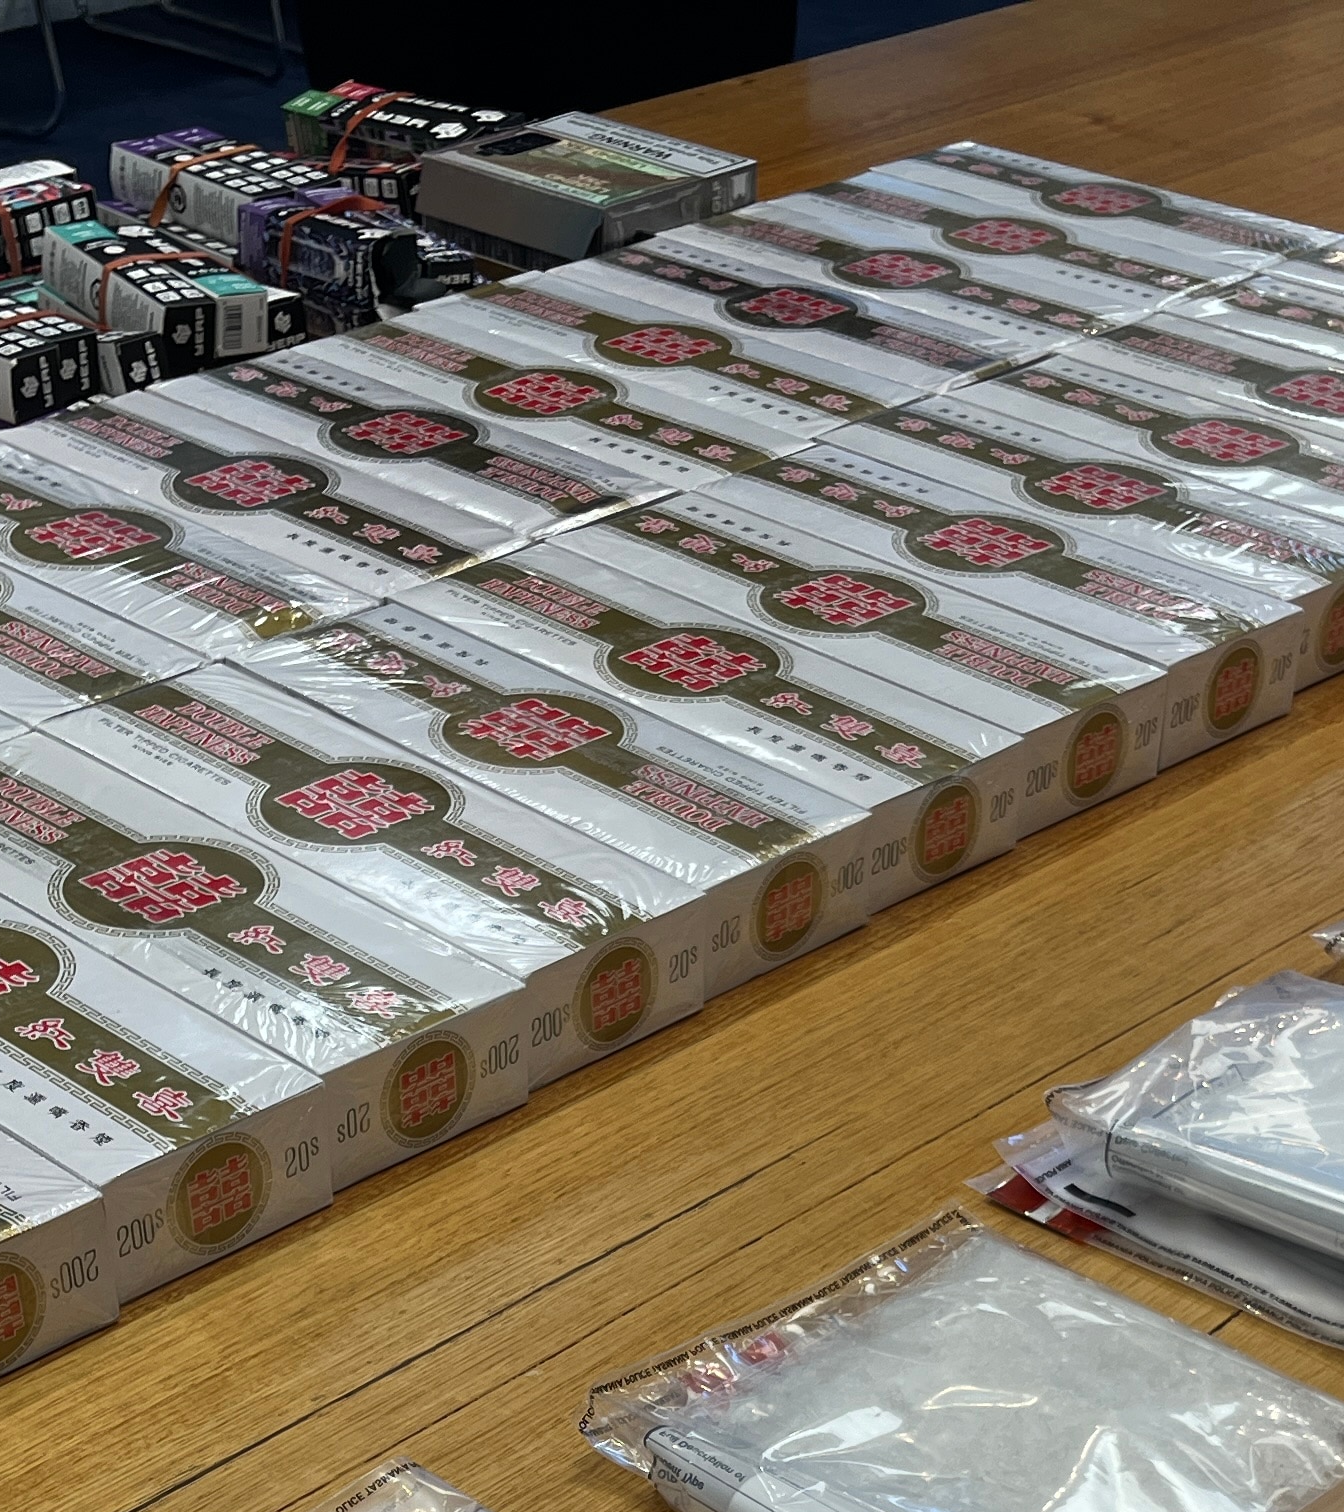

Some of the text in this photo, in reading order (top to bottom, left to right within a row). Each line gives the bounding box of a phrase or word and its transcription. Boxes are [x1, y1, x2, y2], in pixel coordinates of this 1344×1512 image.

[870, 835, 909, 876] 200s
[831, 857, 865, 899] 200s
[711, 915, 741, 953] 20s
[668, 945, 699, 985] 20s
[530, 1004, 572, 1049] 200s
[481, 1034, 520, 1081] 200s
[336, 1102, 372, 1145] 20s
[284, 1137, 321, 1179] 20s
[116, 1208, 165, 1261] 200s
[51, 1249, 99, 1299] 200s
